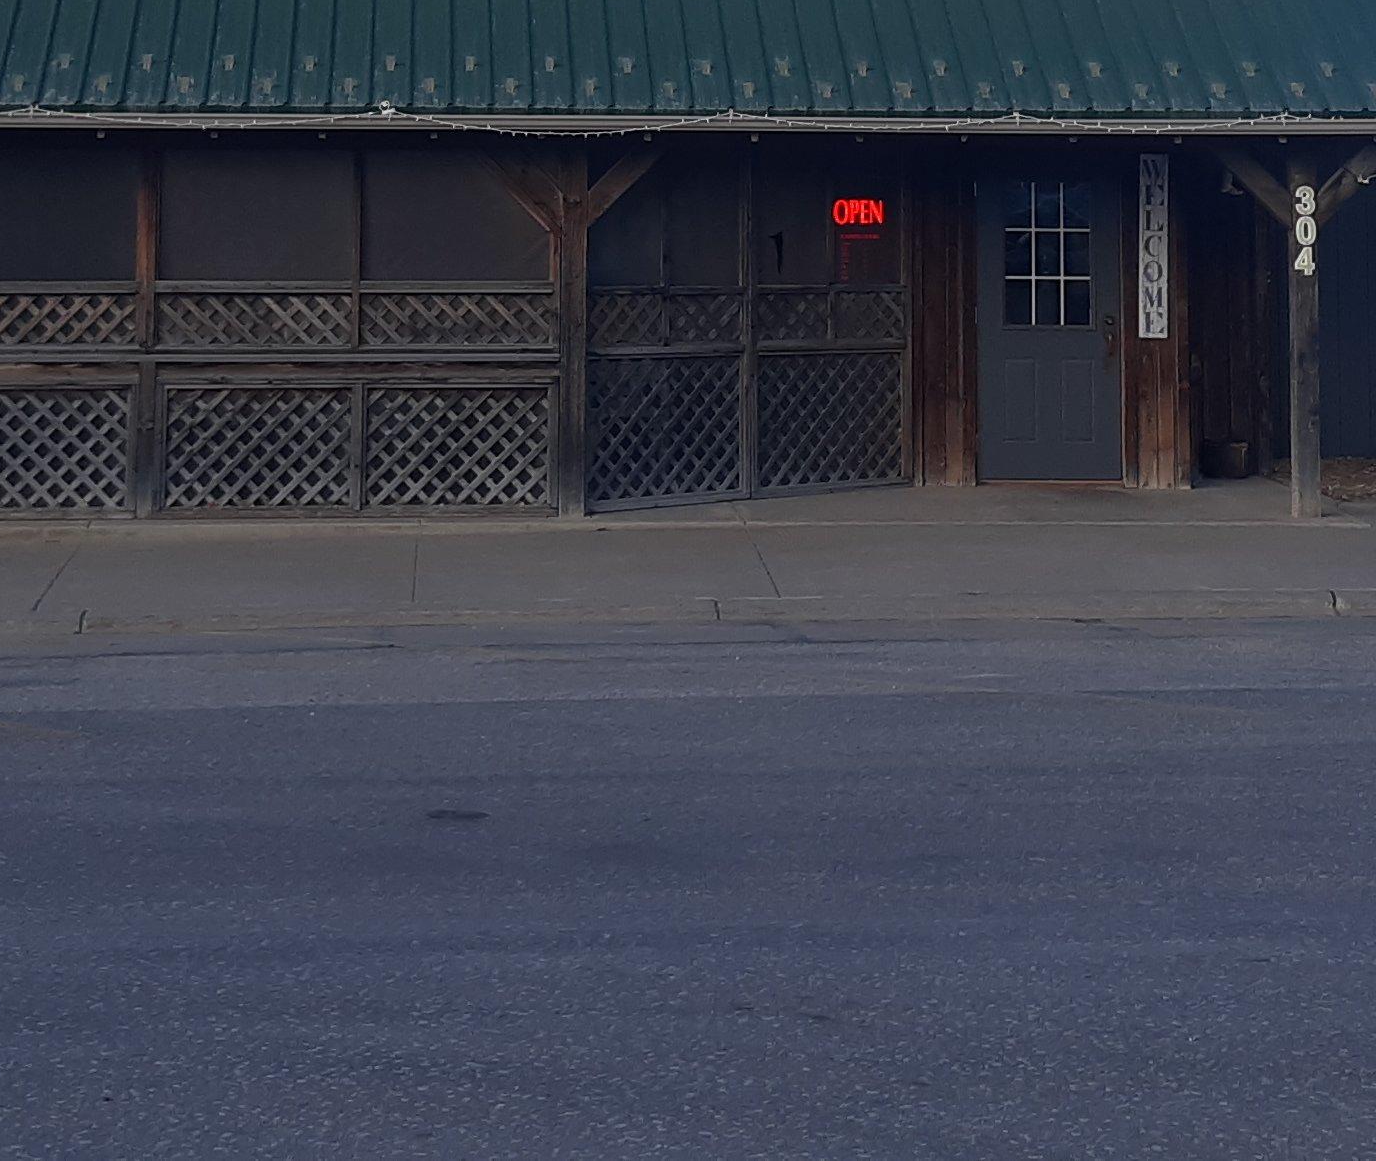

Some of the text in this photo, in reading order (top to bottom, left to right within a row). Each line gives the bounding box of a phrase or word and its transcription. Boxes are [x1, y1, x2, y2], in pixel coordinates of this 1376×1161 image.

[832, 199, 884, 226] OPEN
[1142, 159, 1165, 334] WELCOME
[1294, 185, 1317, 276] 304
